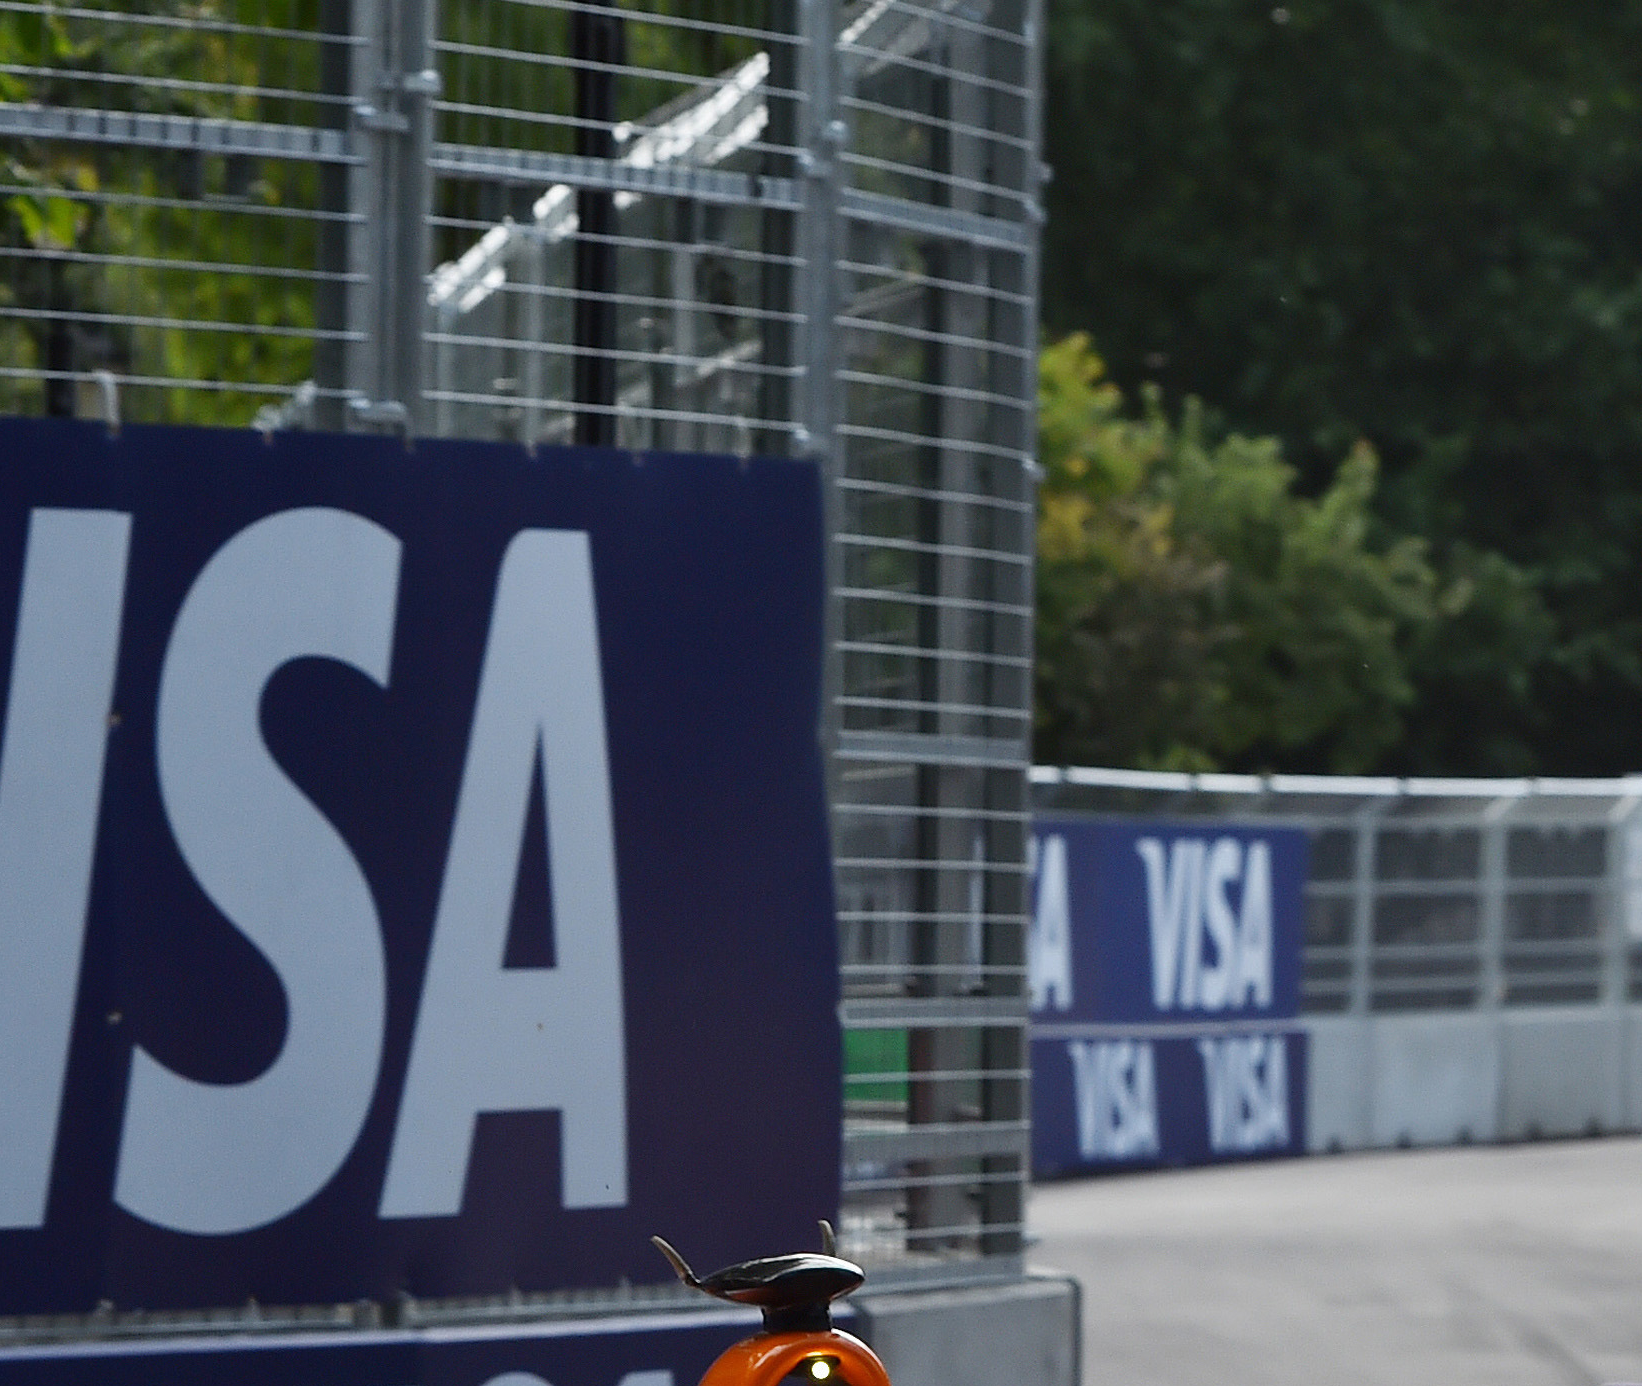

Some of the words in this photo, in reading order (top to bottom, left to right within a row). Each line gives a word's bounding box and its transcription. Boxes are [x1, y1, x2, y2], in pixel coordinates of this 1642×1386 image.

[1136, 836, 1273, 1011] VISA
[1069, 1038, 1160, 1161] VISA
[1198, 1036, 1289, 1151] VISA
